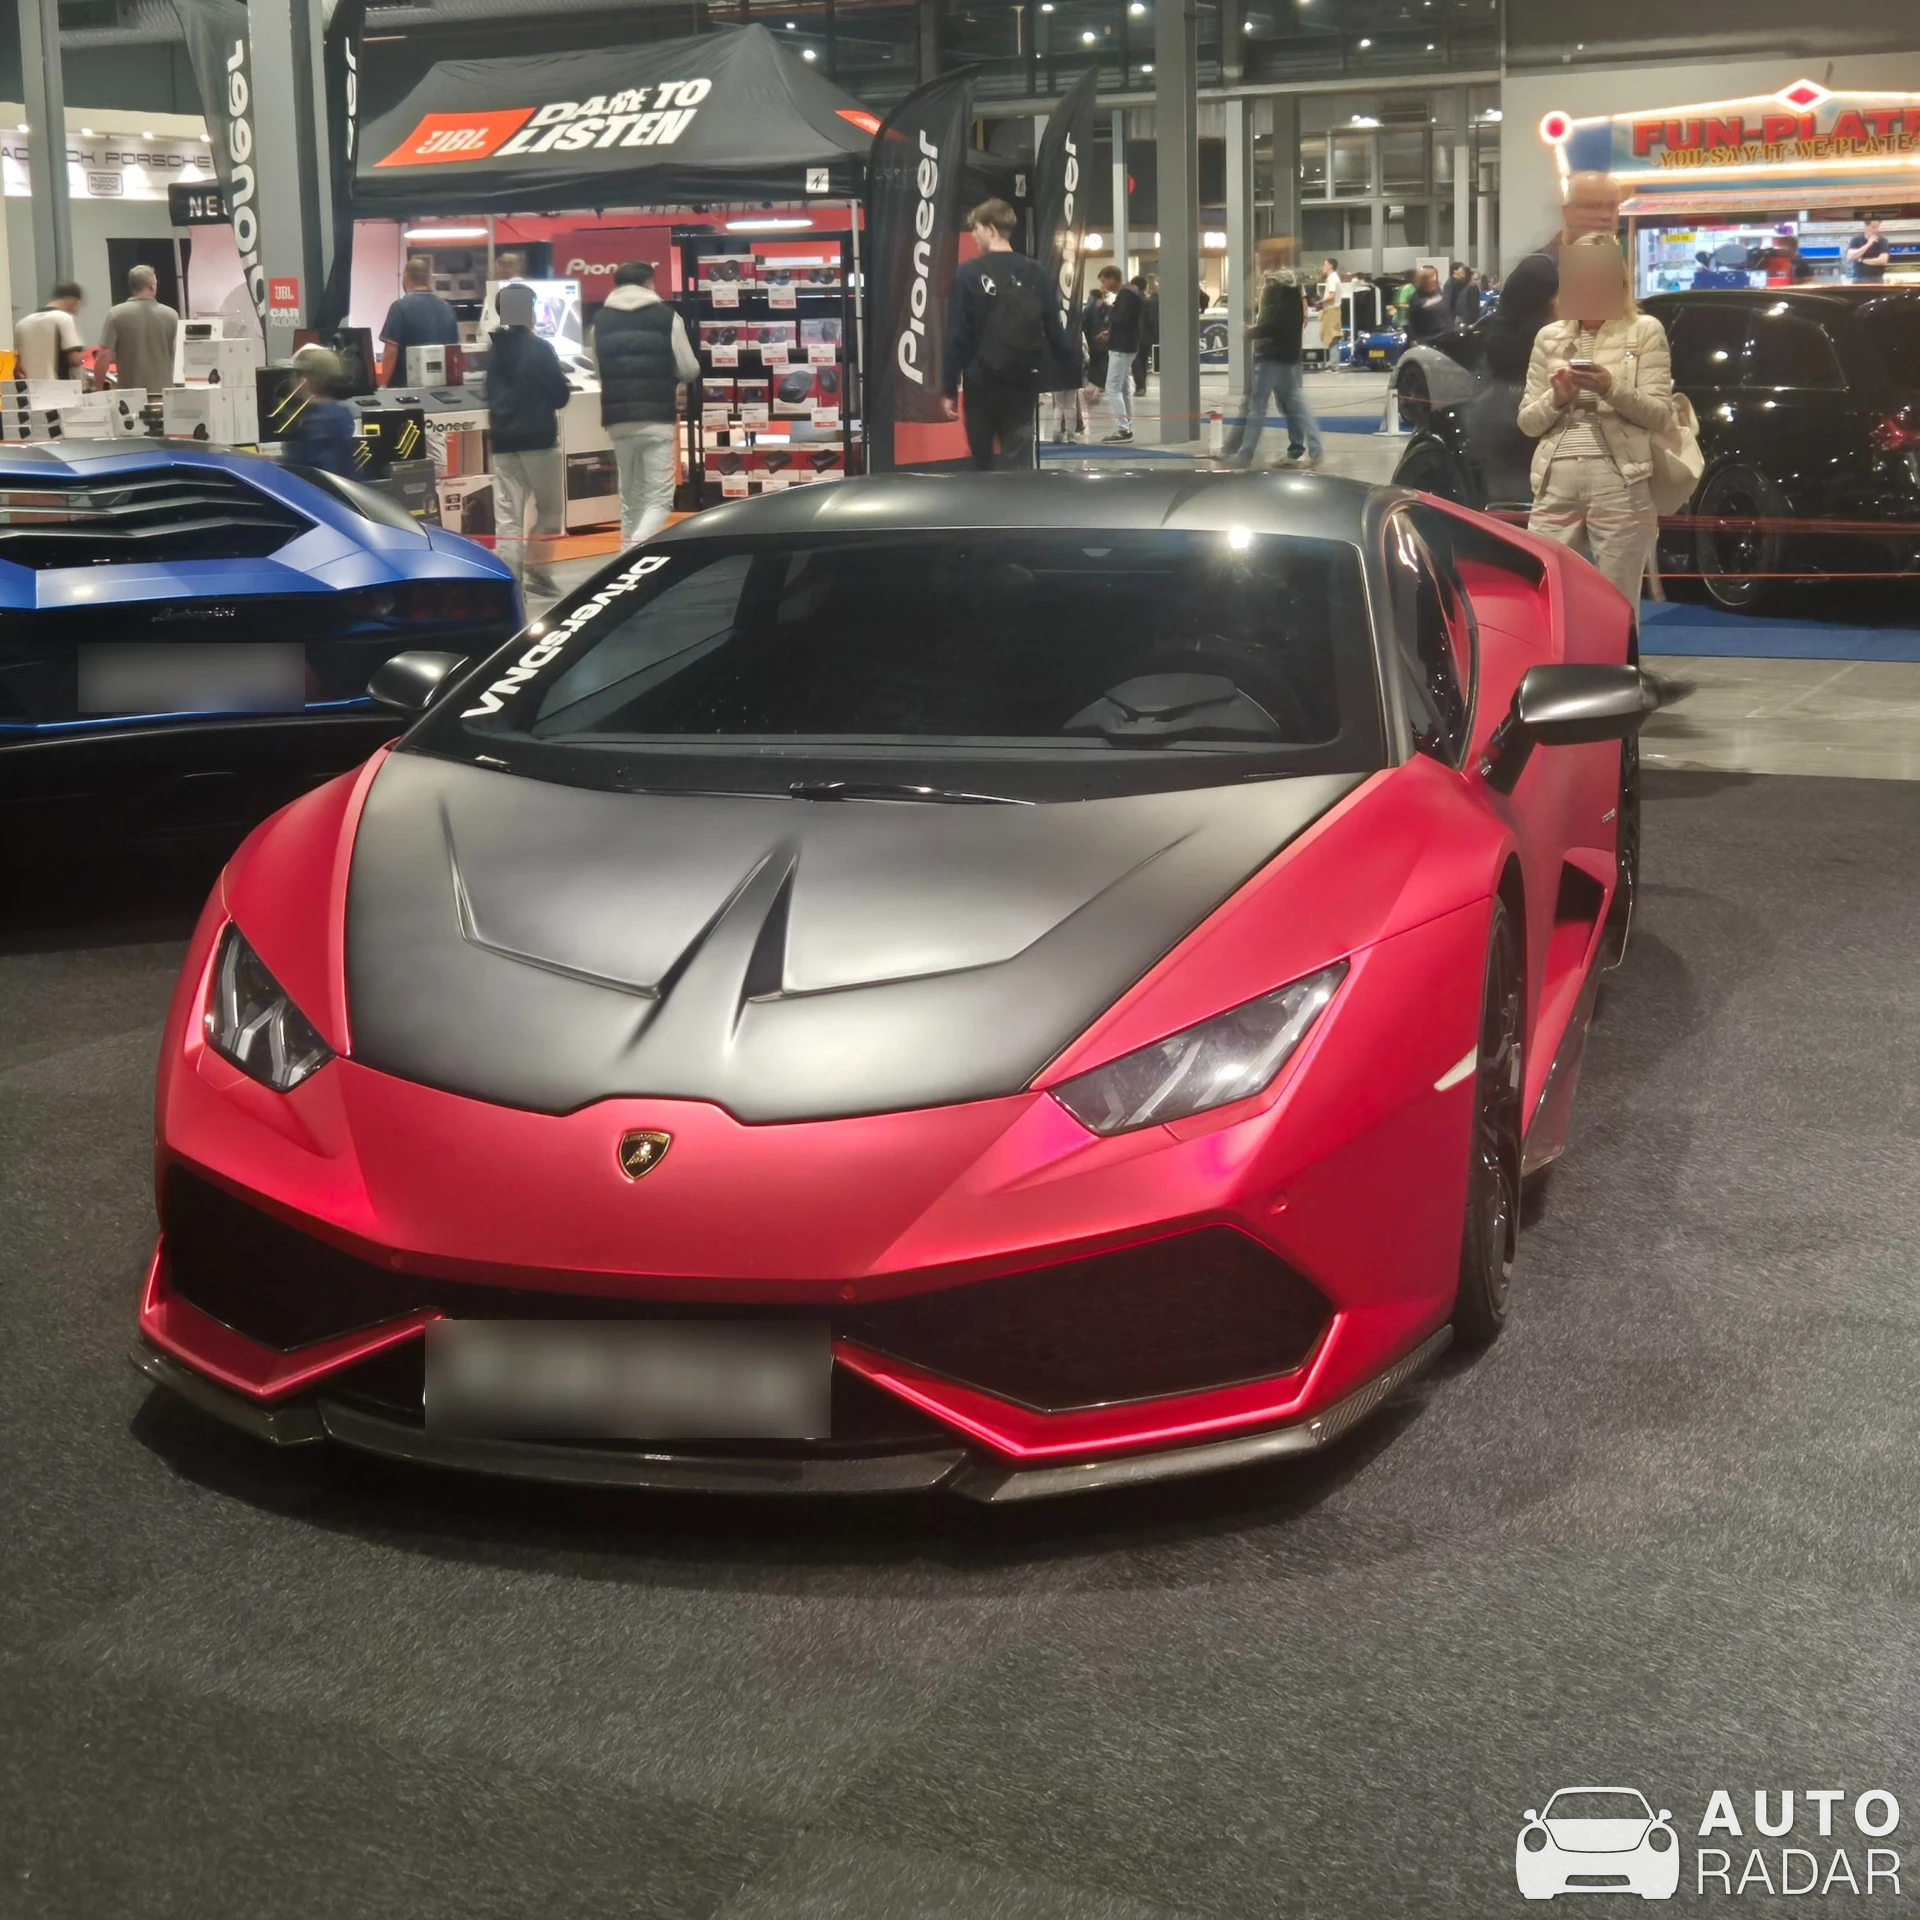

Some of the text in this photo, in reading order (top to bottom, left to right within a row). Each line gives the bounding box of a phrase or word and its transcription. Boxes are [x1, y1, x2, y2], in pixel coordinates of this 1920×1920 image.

[527, 78, 713, 128] DARE TO
[415, 128, 489, 154] JBL
[492, 108, 698, 157] LISTEN
[0, 147, 211, 168] ADCK PORSCHE
[1659, 133, 1914, 169] YOU SAY IT WE PLATE
[566, 258, 659, 276] Pionr
[897, 129, 939, 385] Pioneer
[274, 285, 295, 300] JBL
[270, 308, 300, 318] CAR
[425, 419, 477, 432] Pioneer
